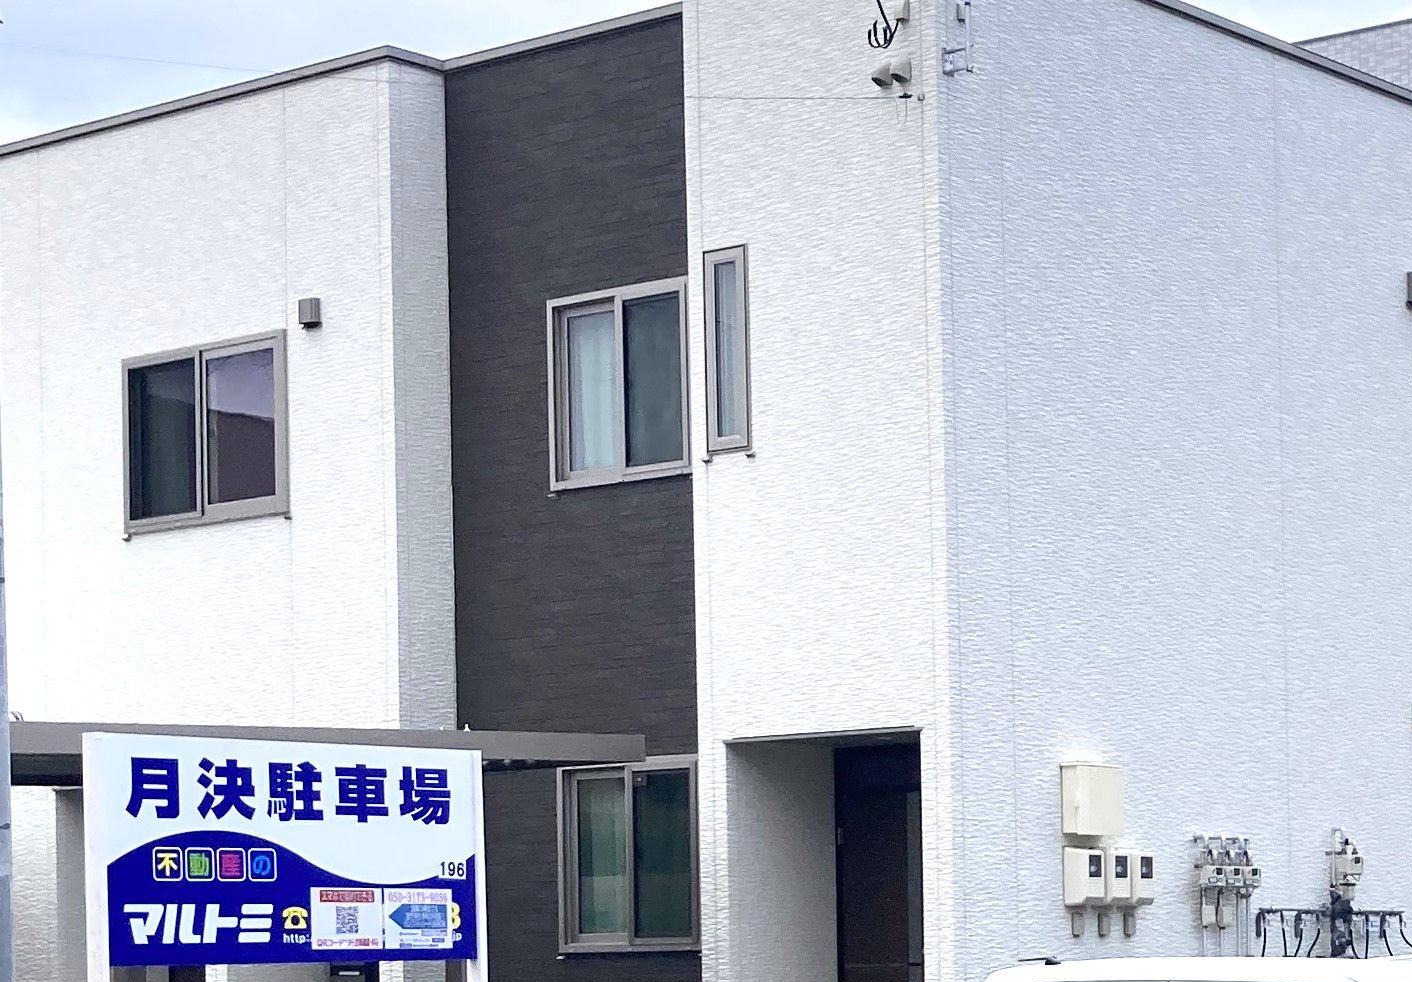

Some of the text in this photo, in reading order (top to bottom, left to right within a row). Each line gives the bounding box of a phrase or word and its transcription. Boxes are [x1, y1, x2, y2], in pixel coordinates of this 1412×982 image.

[126, 757, 451, 824] 月決駐車場
[156, 852, 272, 877] 不動産の
[440, 861, 465, 877] 196
[123, 903, 274, 945] マルトミ
